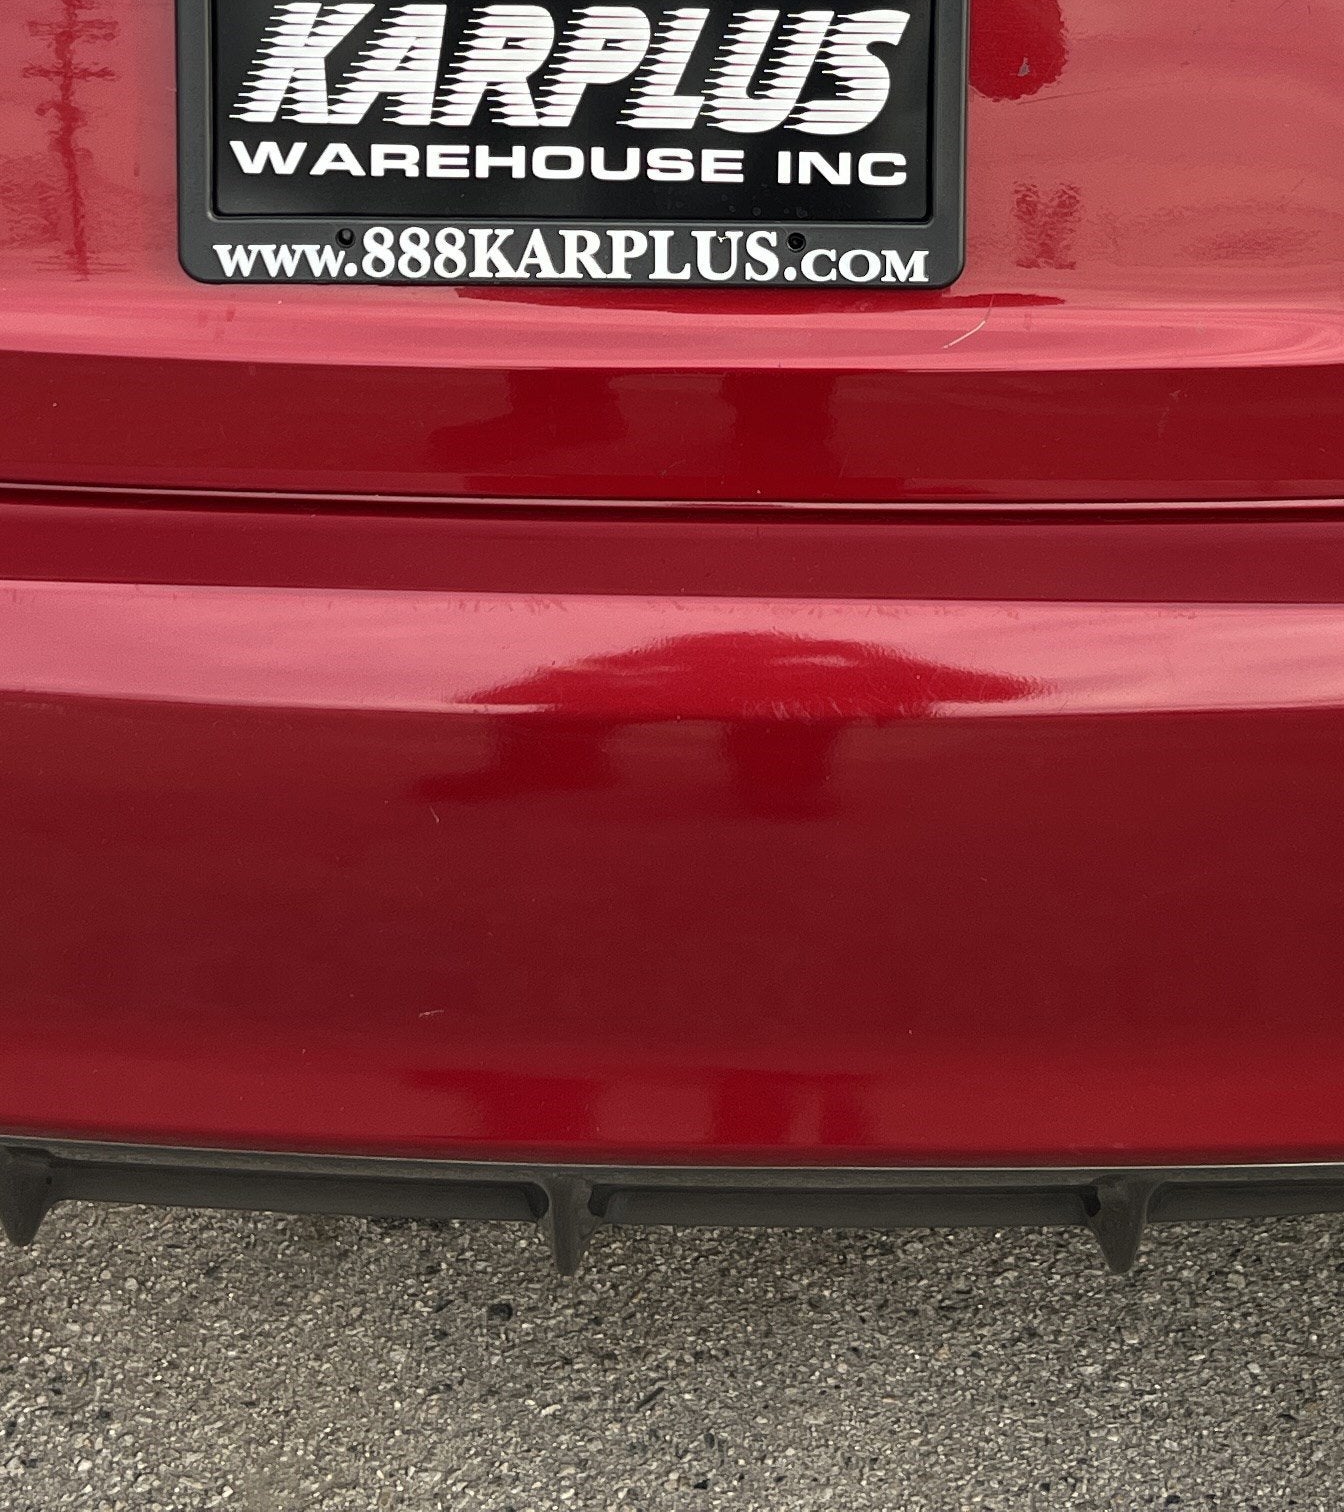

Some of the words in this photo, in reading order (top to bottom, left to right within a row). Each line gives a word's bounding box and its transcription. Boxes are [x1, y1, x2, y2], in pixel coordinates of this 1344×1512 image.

[229, 1, 911, 135] KARPLUS
[229, 139, 745, 184] WAREHOUSE
[777, 149, 908, 186] INC
